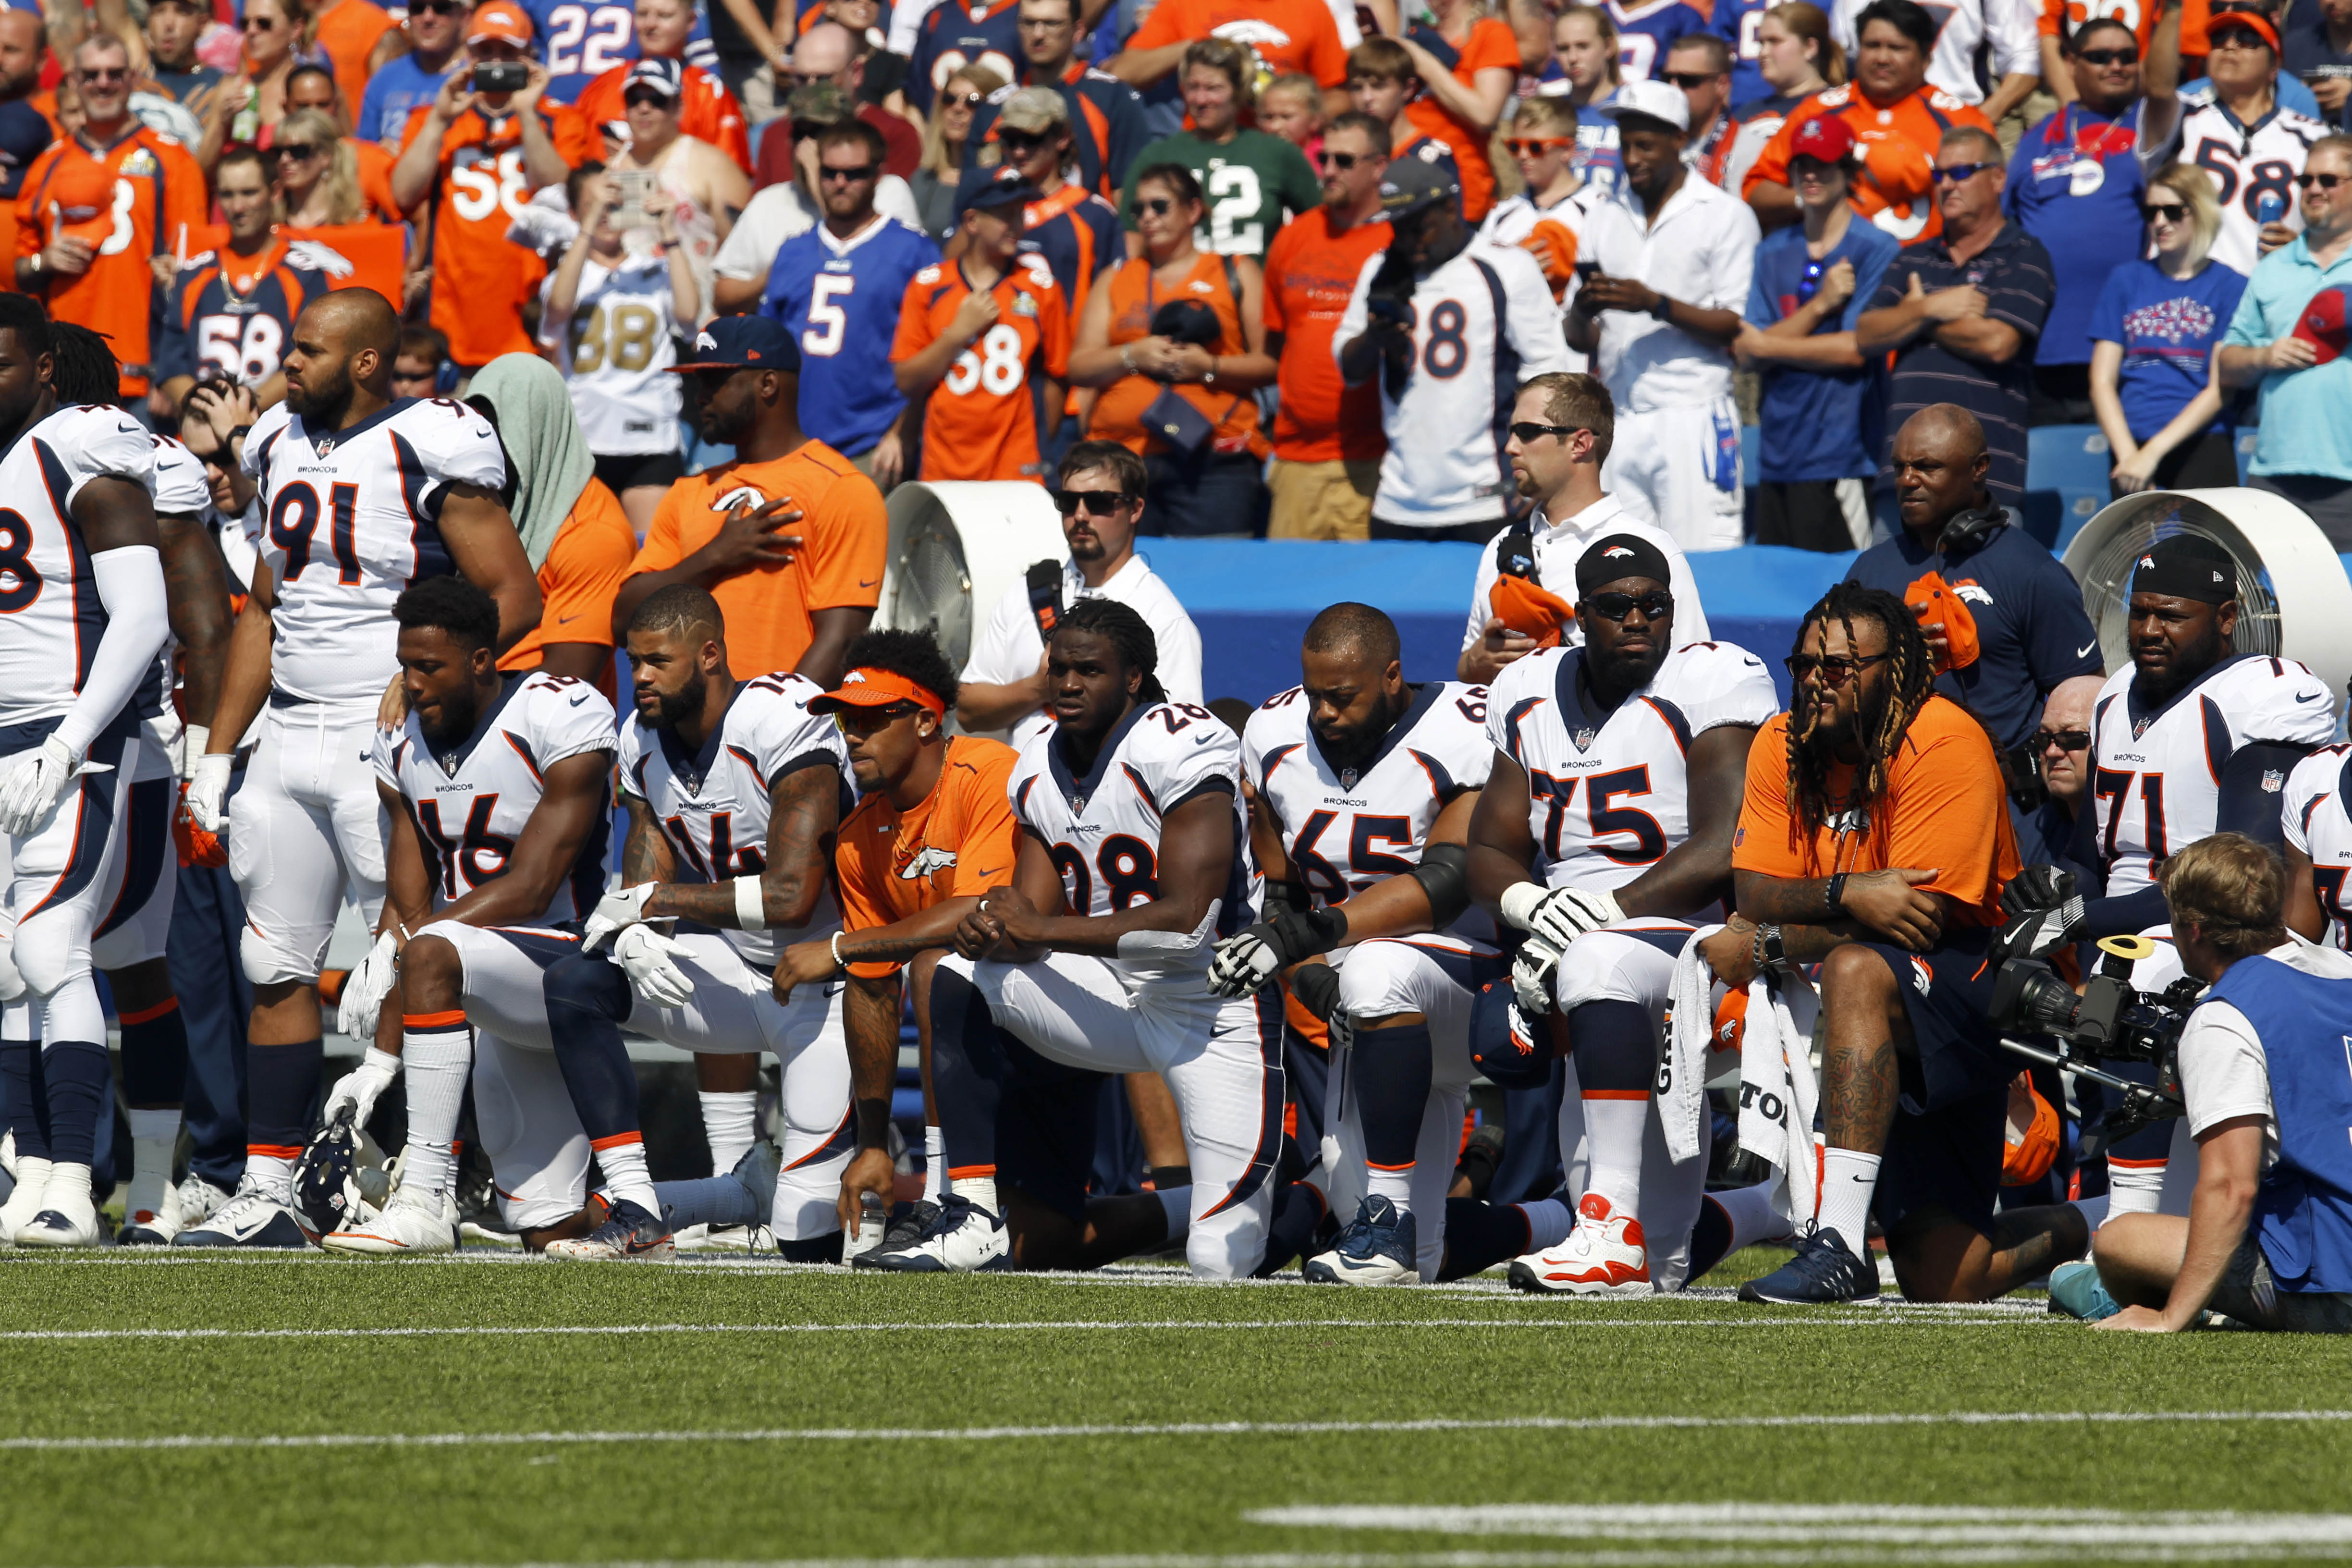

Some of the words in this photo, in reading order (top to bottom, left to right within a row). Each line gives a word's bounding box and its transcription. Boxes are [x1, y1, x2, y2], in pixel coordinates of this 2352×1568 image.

[547, 4, 633, 75] 22
[453, 146, 534, 222] 58
[1191, 165, 1263, 255] 2
[2196, 136, 2295, 225] 58
[197, 313, 283, 384] 58
[568, 304, 657, 374] 88
[802, 273, 855, 358] 5
[1412, 299, 1468, 380] 8
[270, 480, 362, 586] 91
[1147, 703, 1211, 735] 28
[435, 784, 474, 793] BRONCOS
[1562, 759, 1602, 769] BRONCOS
[2114, 754, 2146, 762] BRONCOS
[2264, 778, 2279, 789] NFL
[1066, 825, 1102, 834] BRONCOS
[1323, 798, 1367, 807] BRONCOS
[1530, 763, 1667, 866] 75
[2096, 766, 2169, 880] 71
[417, 793, 515, 900] 16
[1290, 809, 1418, 906] 65
